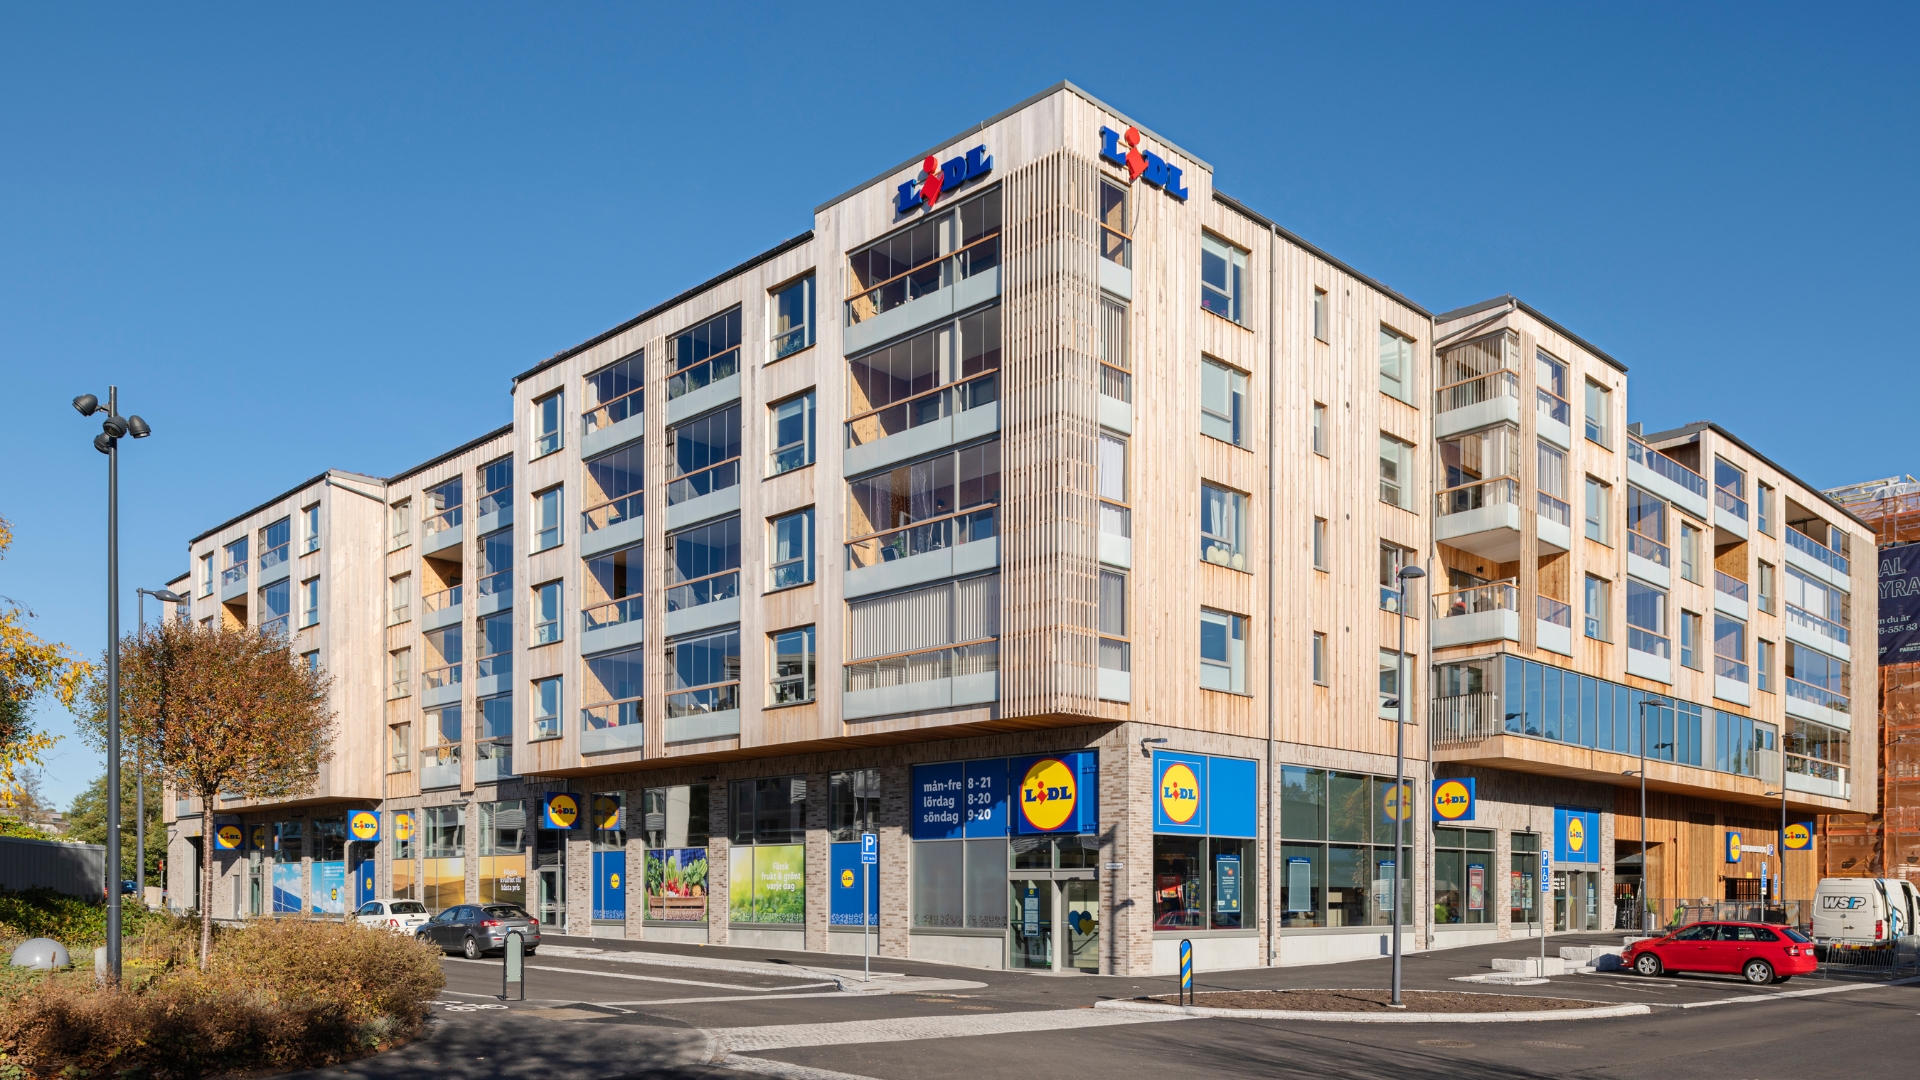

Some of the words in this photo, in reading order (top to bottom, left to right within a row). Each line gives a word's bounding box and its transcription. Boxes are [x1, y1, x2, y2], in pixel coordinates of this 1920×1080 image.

[1887, 615, 1899, 623] du
[1900, 614, 1911, 622] är
[923, 779, 962, 792] mån-fre
[923, 795, 955, 809] lördag
[923, 810, 959, 825] söndag
[865, 836, 874, 852] P
[1543, 851, 1548, 865] P
[772, 861, 789, 871] Färsk
[761, 872, 777, 880] frukt
[778, 872, 783, 880] &
[783, 871, 801, 882] grönt
[766, 882, 782, 892] varje
[783, 882, 795, 892] dag
